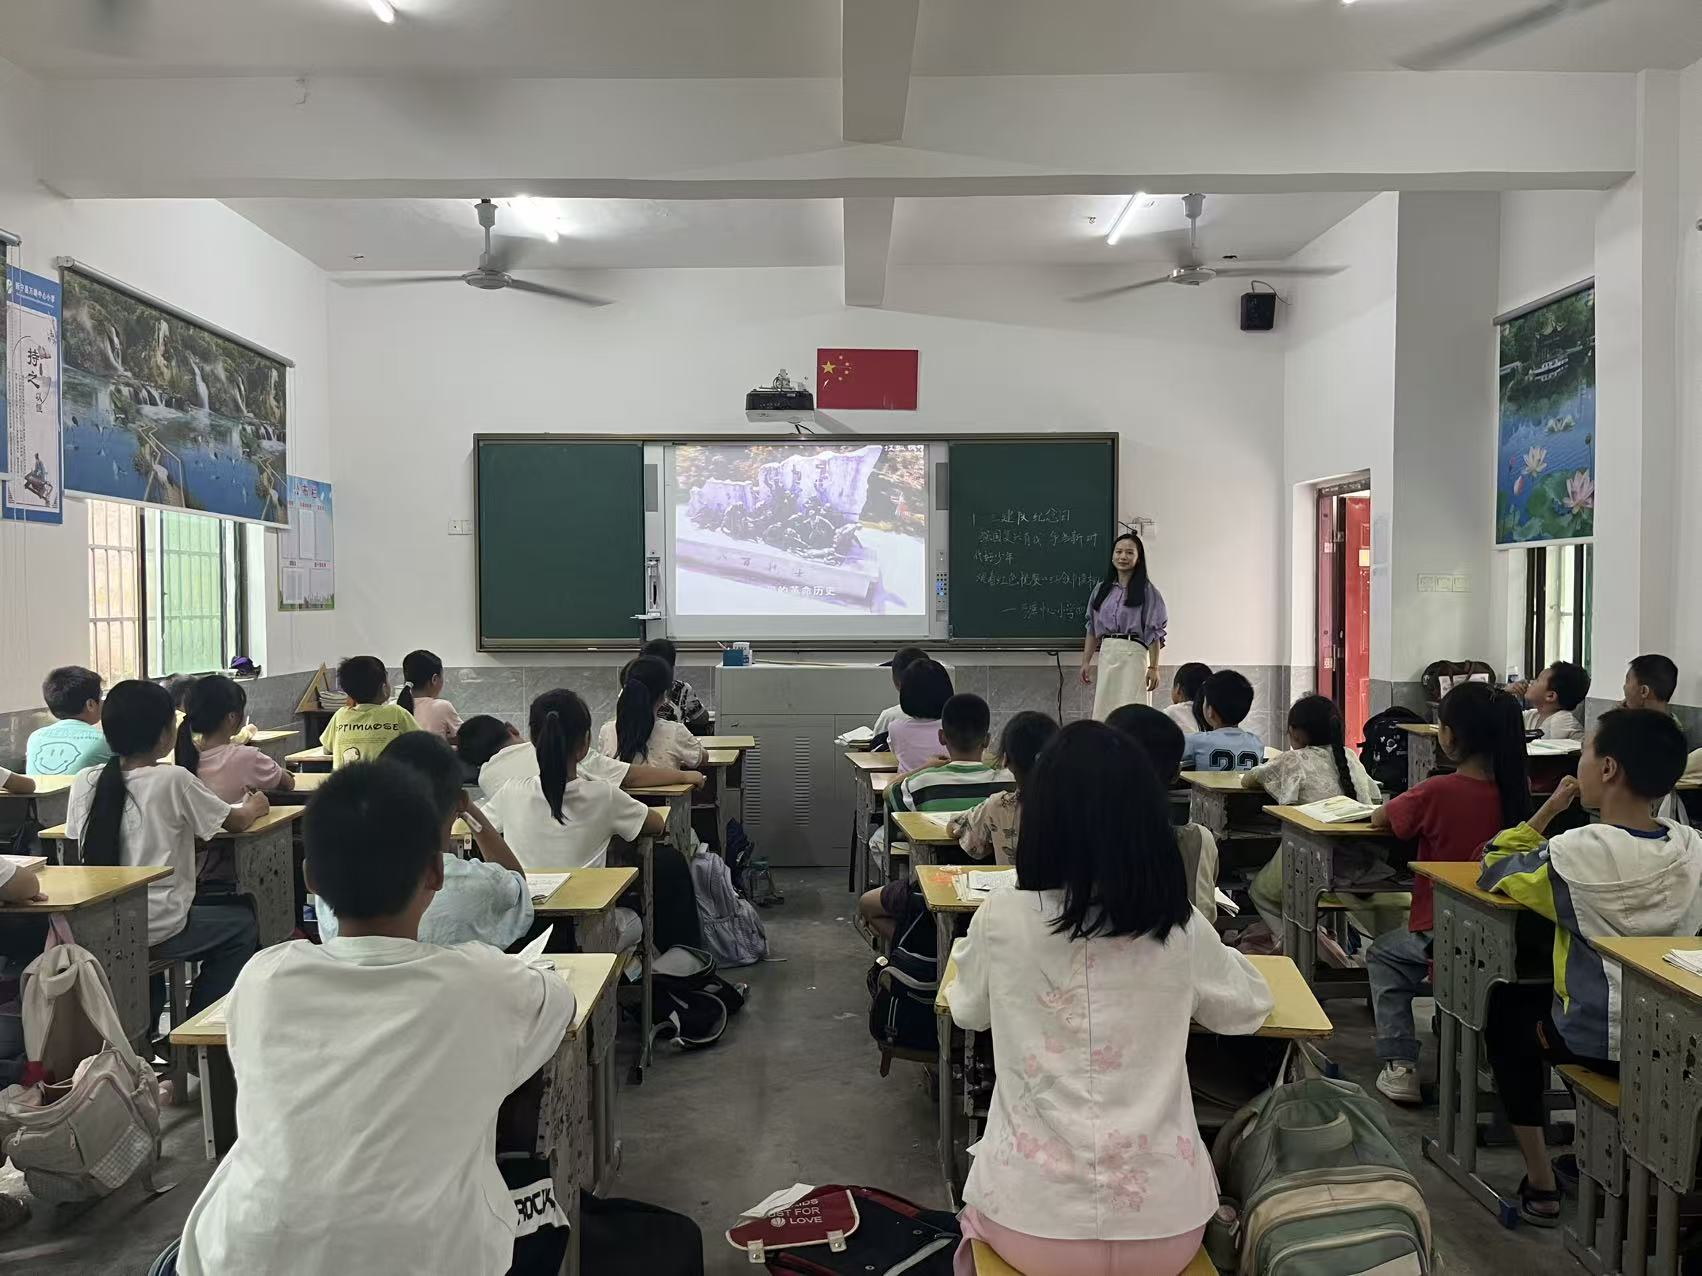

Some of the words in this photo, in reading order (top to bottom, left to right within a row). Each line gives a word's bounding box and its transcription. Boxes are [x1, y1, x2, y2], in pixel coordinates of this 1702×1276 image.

[514, 1188, 556, 1226] ROCK
[795, 1199, 819, 1207] IDS
[770, 1210, 791, 1218] UST
[795, 1207, 820, 1216] FOR
[790, 1216, 823, 1224] LOVE
